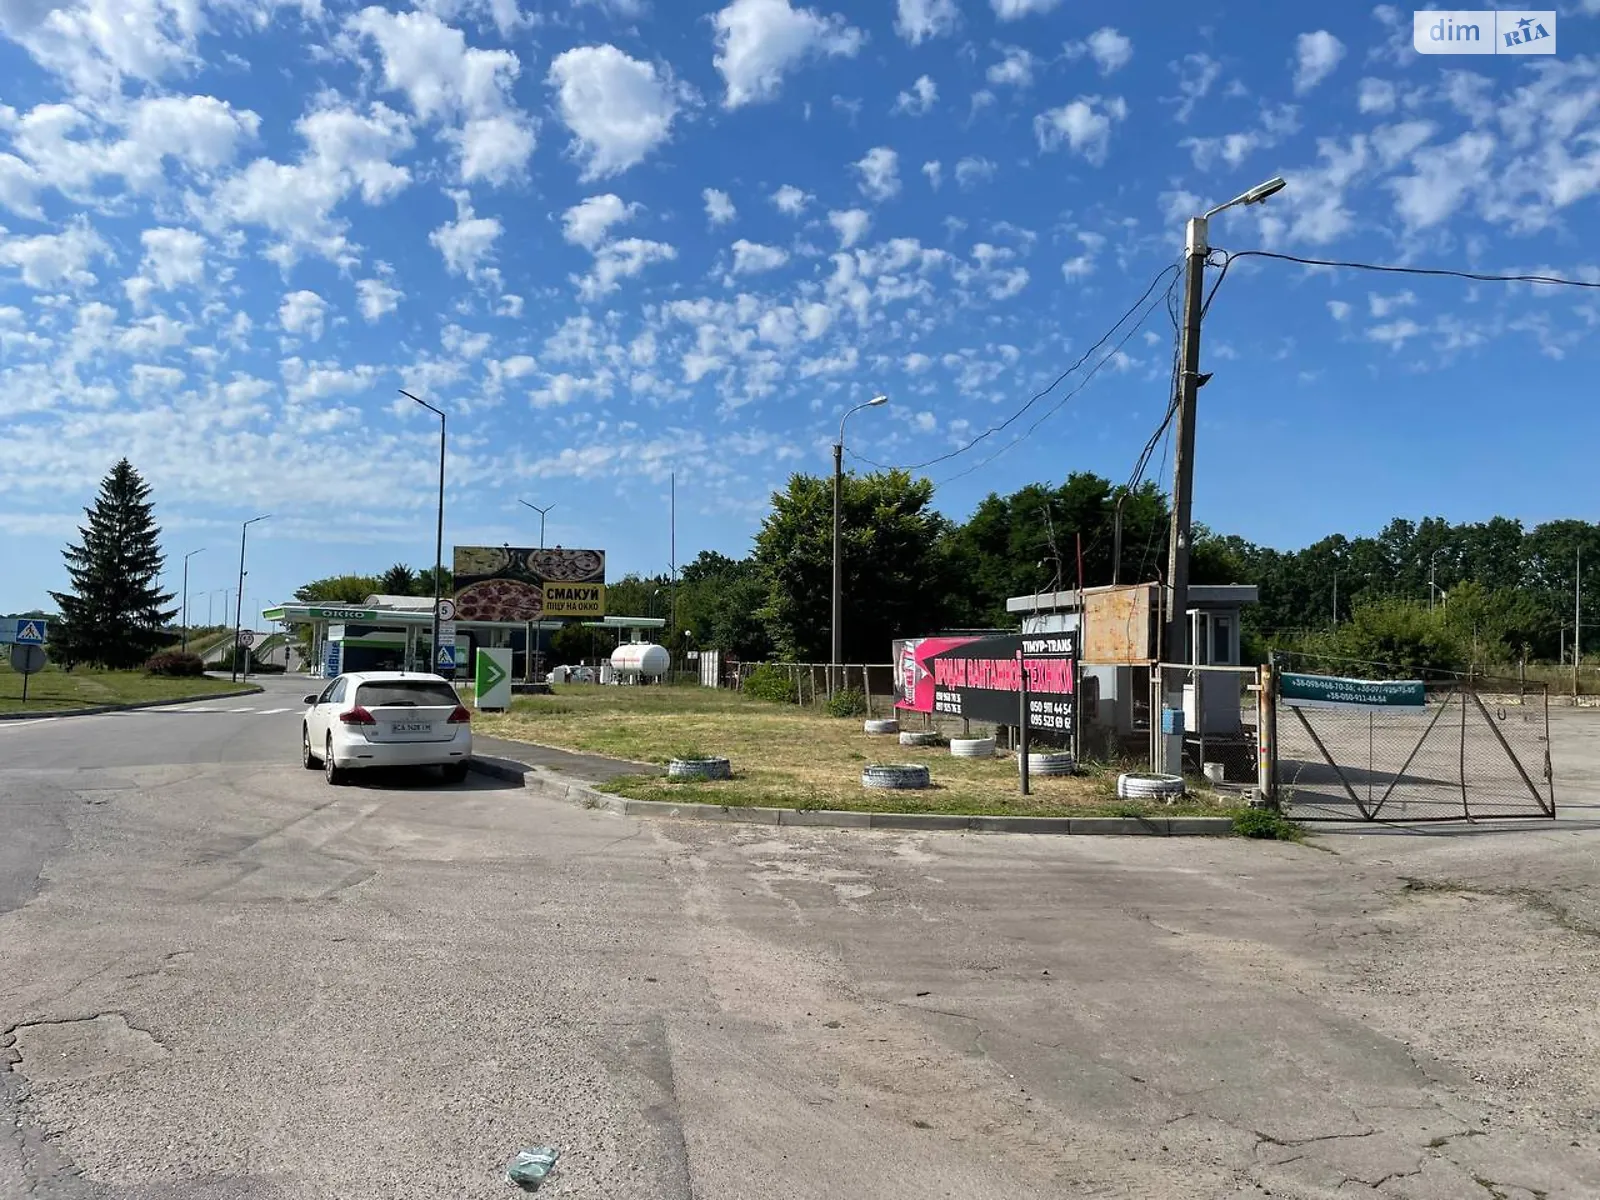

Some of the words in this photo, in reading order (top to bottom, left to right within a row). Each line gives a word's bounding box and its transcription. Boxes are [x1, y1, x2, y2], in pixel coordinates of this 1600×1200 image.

[547, 586, 599, 600] СМАКУЙ
[441, 606, 448, 615] 5
[566, 602, 577, 610] НА
[327, 641, 340, 678] AdBlue
[1054, 702, 1063, 714] 44
